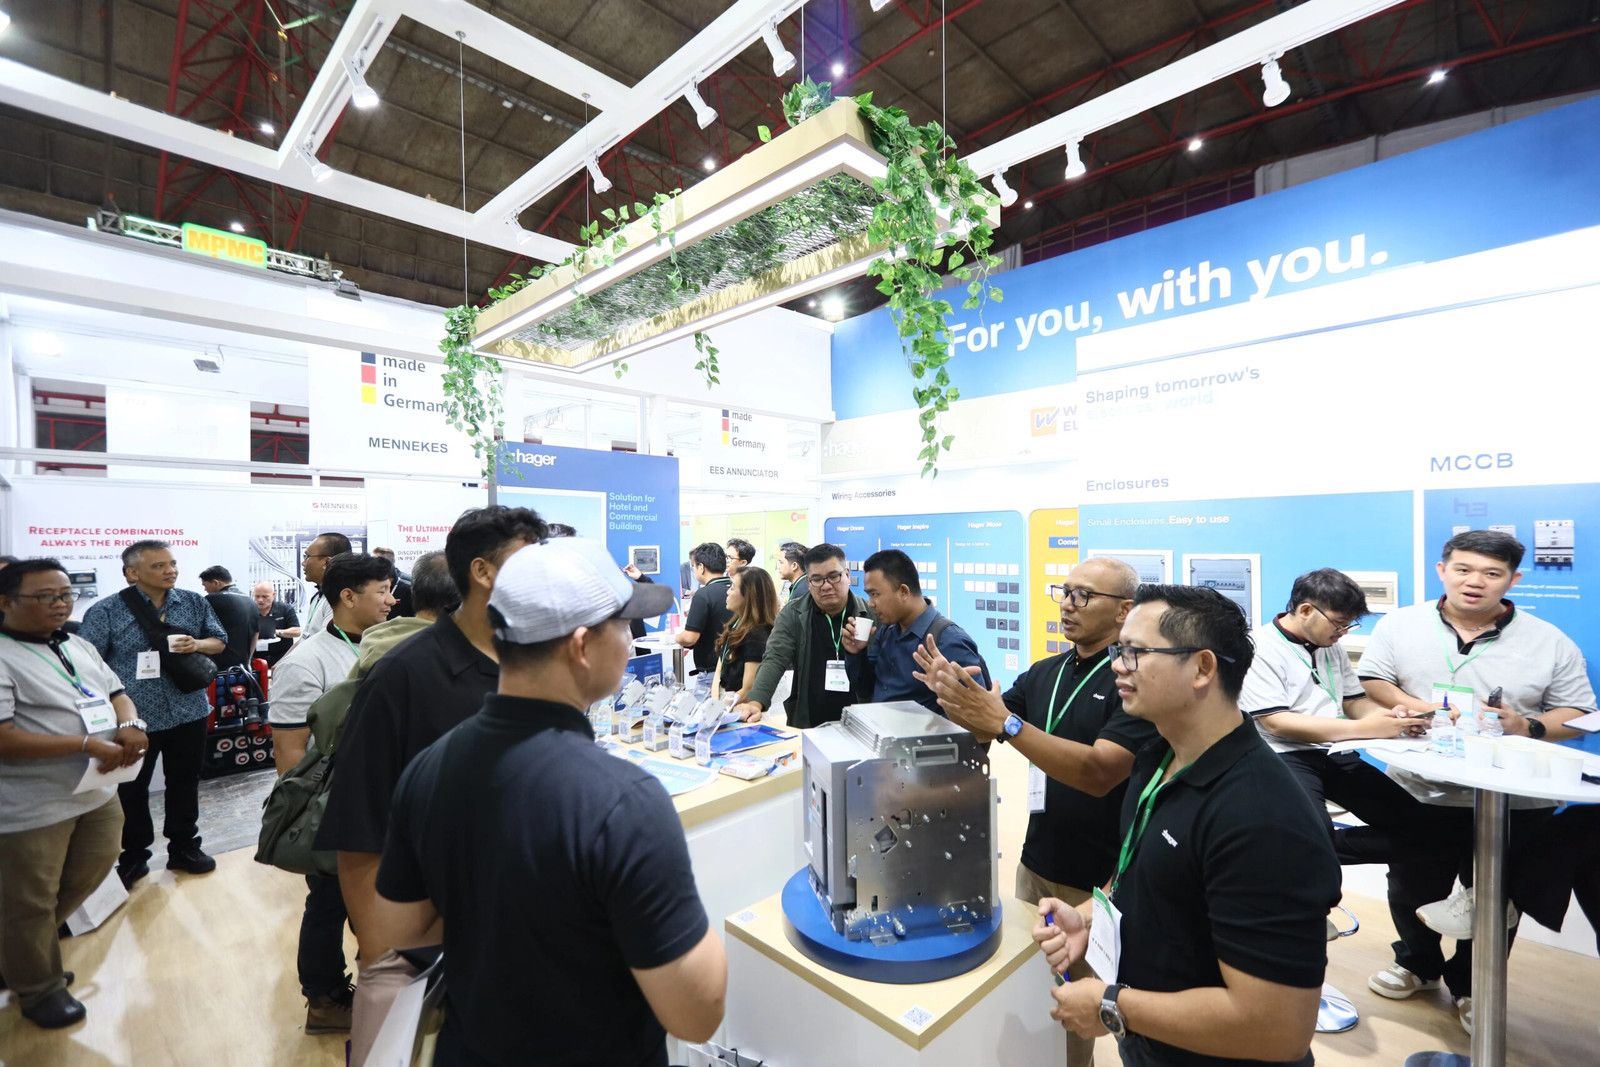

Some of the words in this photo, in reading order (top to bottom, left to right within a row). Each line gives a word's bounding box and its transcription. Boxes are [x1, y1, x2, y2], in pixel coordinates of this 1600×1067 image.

[188, 229, 264, 263] MPMC
[947, 320, 1004, 356] For
[1015, 300, 1103, 350] you,
[1118, 263, 1231, 319] with
[1246, 233, 1389, 300] you.
[383, 356, 426, 373] made
[383, 373, 397, 388] in
[1086, 386, 1149, 403] Shaping
[1155, 366, 1261, 392] tomorrow's
[384, 393, 453, 417] Germany
[1063, 405, 1078, 417] W
[732, 410, 753, 422] made
[732, 423, 739, 433] in
[1063, 420, 1079, 431] EL
[369, 437, 449, 453] MENNEKES
[732, 437, 766, 452] Germany
[1430, 452, 1514, 472] MCCB
[710, 465, 725, 475] EES
[726, 466, 779, 478] ANNUNCIATOR
[1086, 477, 1170, 491] Enclosures
[609, 492, 643, 502] Solution
[644, 494, 656, 503] for
[832, 492, 853, 501] Wiring
[854, 489, 897, 499] Accessories
[320, 502, 358, 510] MENNEKES
[609, 502, 631, 511] Hotel
[633, 504, 648, 512] and
[609, 511, 658, 522] Commercial
[1087, 517, 1112, 527] Small
[1114, 517, 1168, 527] Enclosures,
[1168, 515, 1194, 526] Easy
[1195, 515, 1207, 524] to
[1209, 515, 1230, 524] use
[29, 526, 101, 535] RECEPTACLE
[104, 528, 185, 536] COMBINATIONS
[609, 521, 643, 533] Building
[41, 539, 87, 547] ALWAYS
[90, 539, 111, 547] THE
[1057, 538, 1079, 546] Comin
